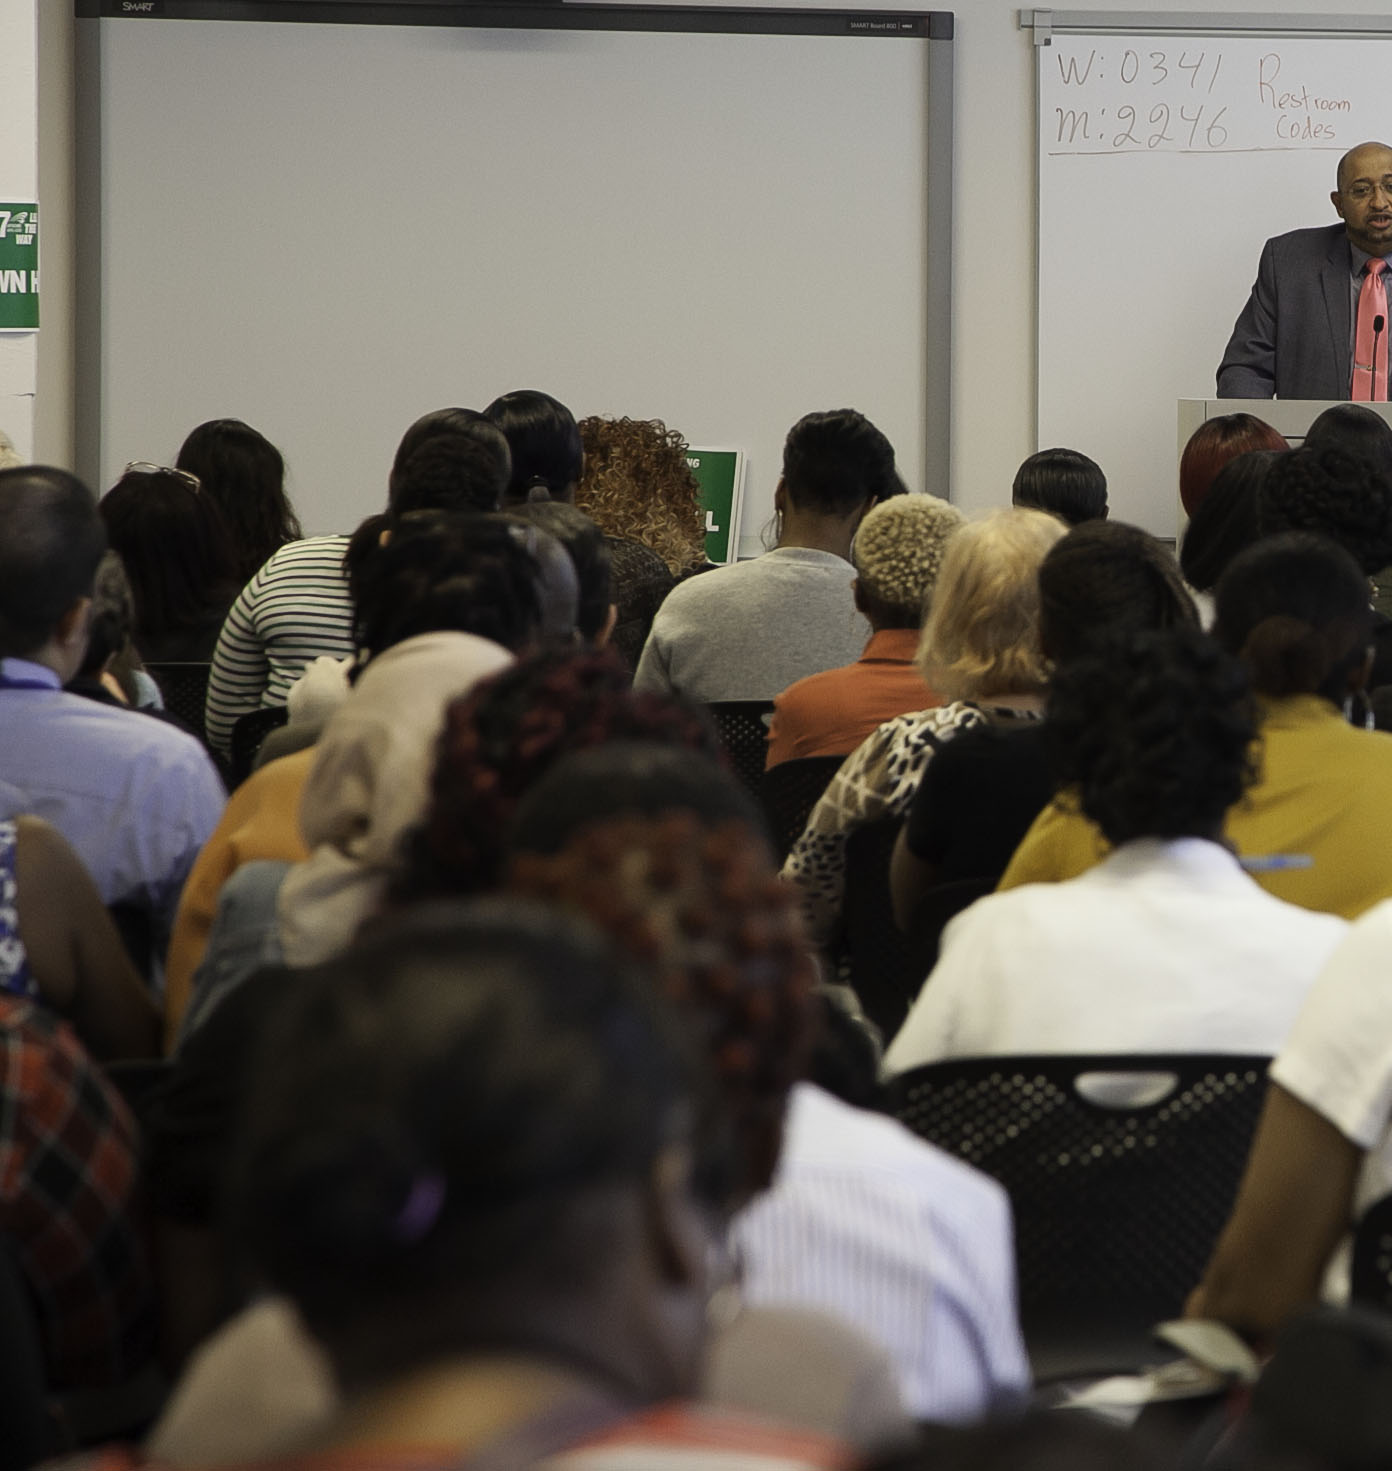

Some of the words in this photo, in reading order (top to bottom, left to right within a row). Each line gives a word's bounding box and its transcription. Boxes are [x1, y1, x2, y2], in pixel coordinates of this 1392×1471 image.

[122, 2, 155, 11] SMART
[1120, 50, 1222, 94] 0341
[1113, 103, 1228, 148] 2246
[1276, 115, 1336, 140] Codes
